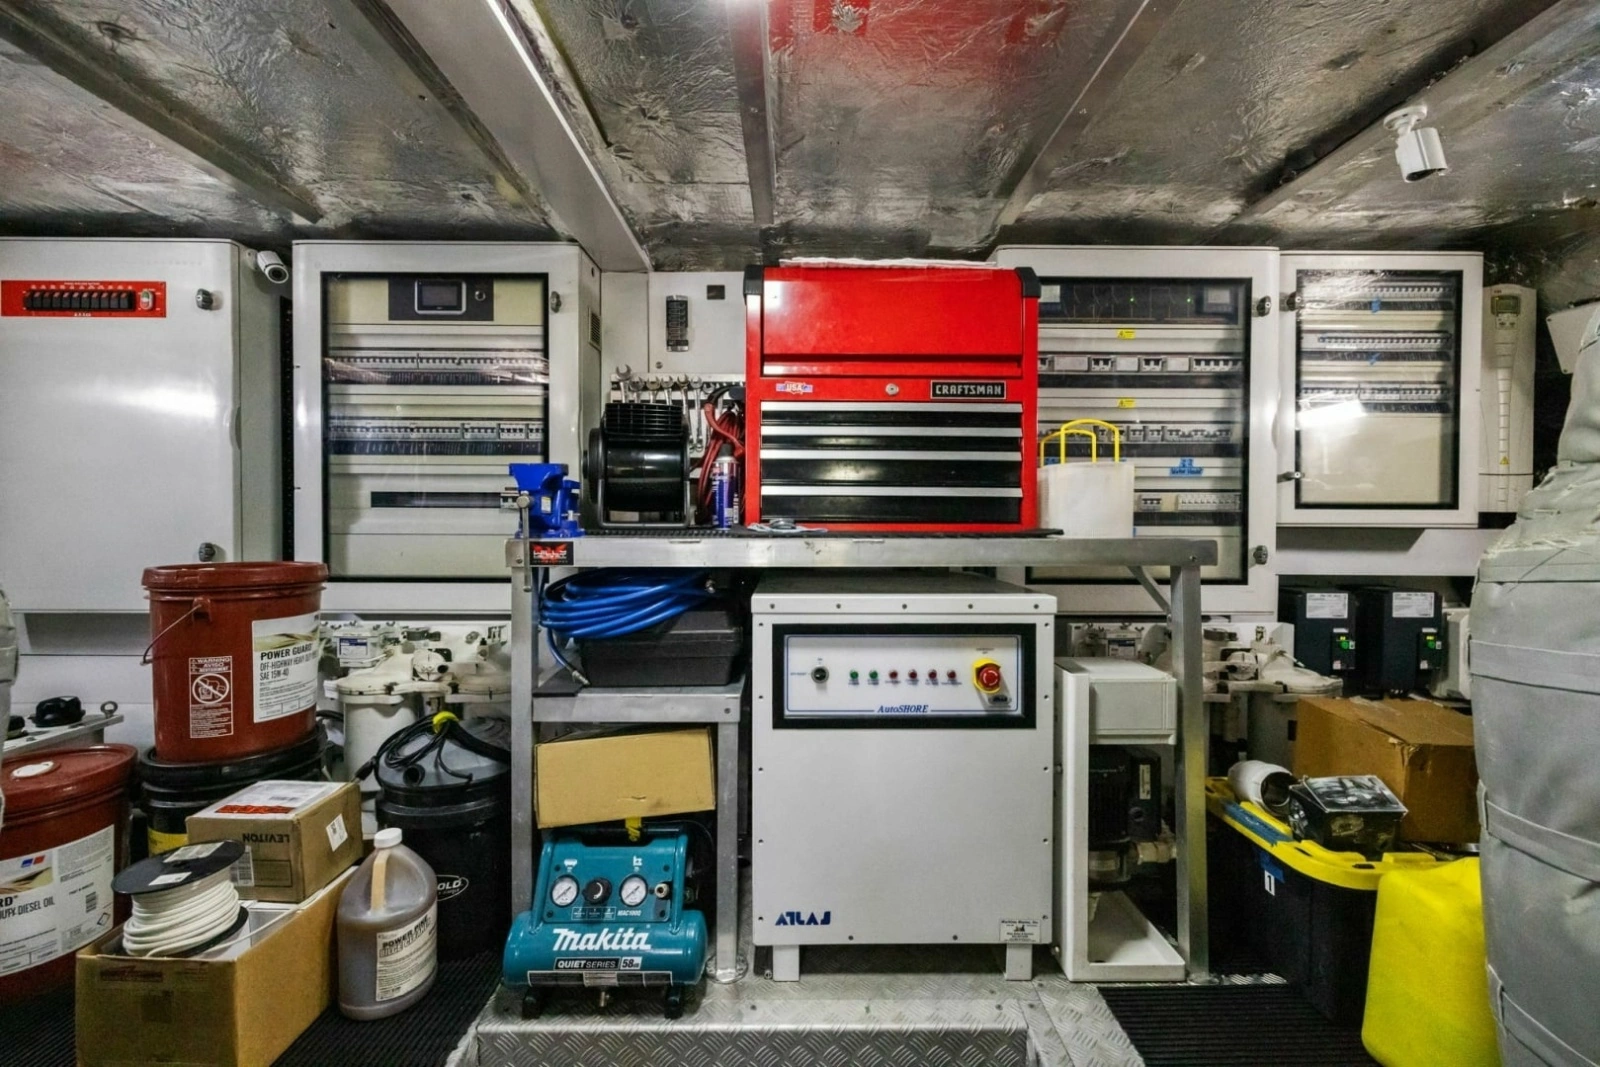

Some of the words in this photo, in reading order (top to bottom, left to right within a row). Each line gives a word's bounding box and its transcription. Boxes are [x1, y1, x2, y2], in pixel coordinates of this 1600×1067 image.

[935, 384, 1002, 395] CRAFTSMAN
[260, 648, 291, 661] POWER
[259, 659, 293, 672] OFF-HIGHWAY
[259, 672, 270, 681] SAE
[877, 704, 930, 714] AutoSHORE
[242, 833, 290, 844] LEVITON
[437, 879, 462, 891] OLD
[18, 901, 41, 915] DIESEL
[43, 895, 55, 908] OIL
[775, 911, 832, 926] ATLAS
[382, 931, 414, 948] POWER
[552, 928, 652, 952] Makita
[557, 960, 586, 968] QUIET
[586, 960, 616, 968] SERIES
